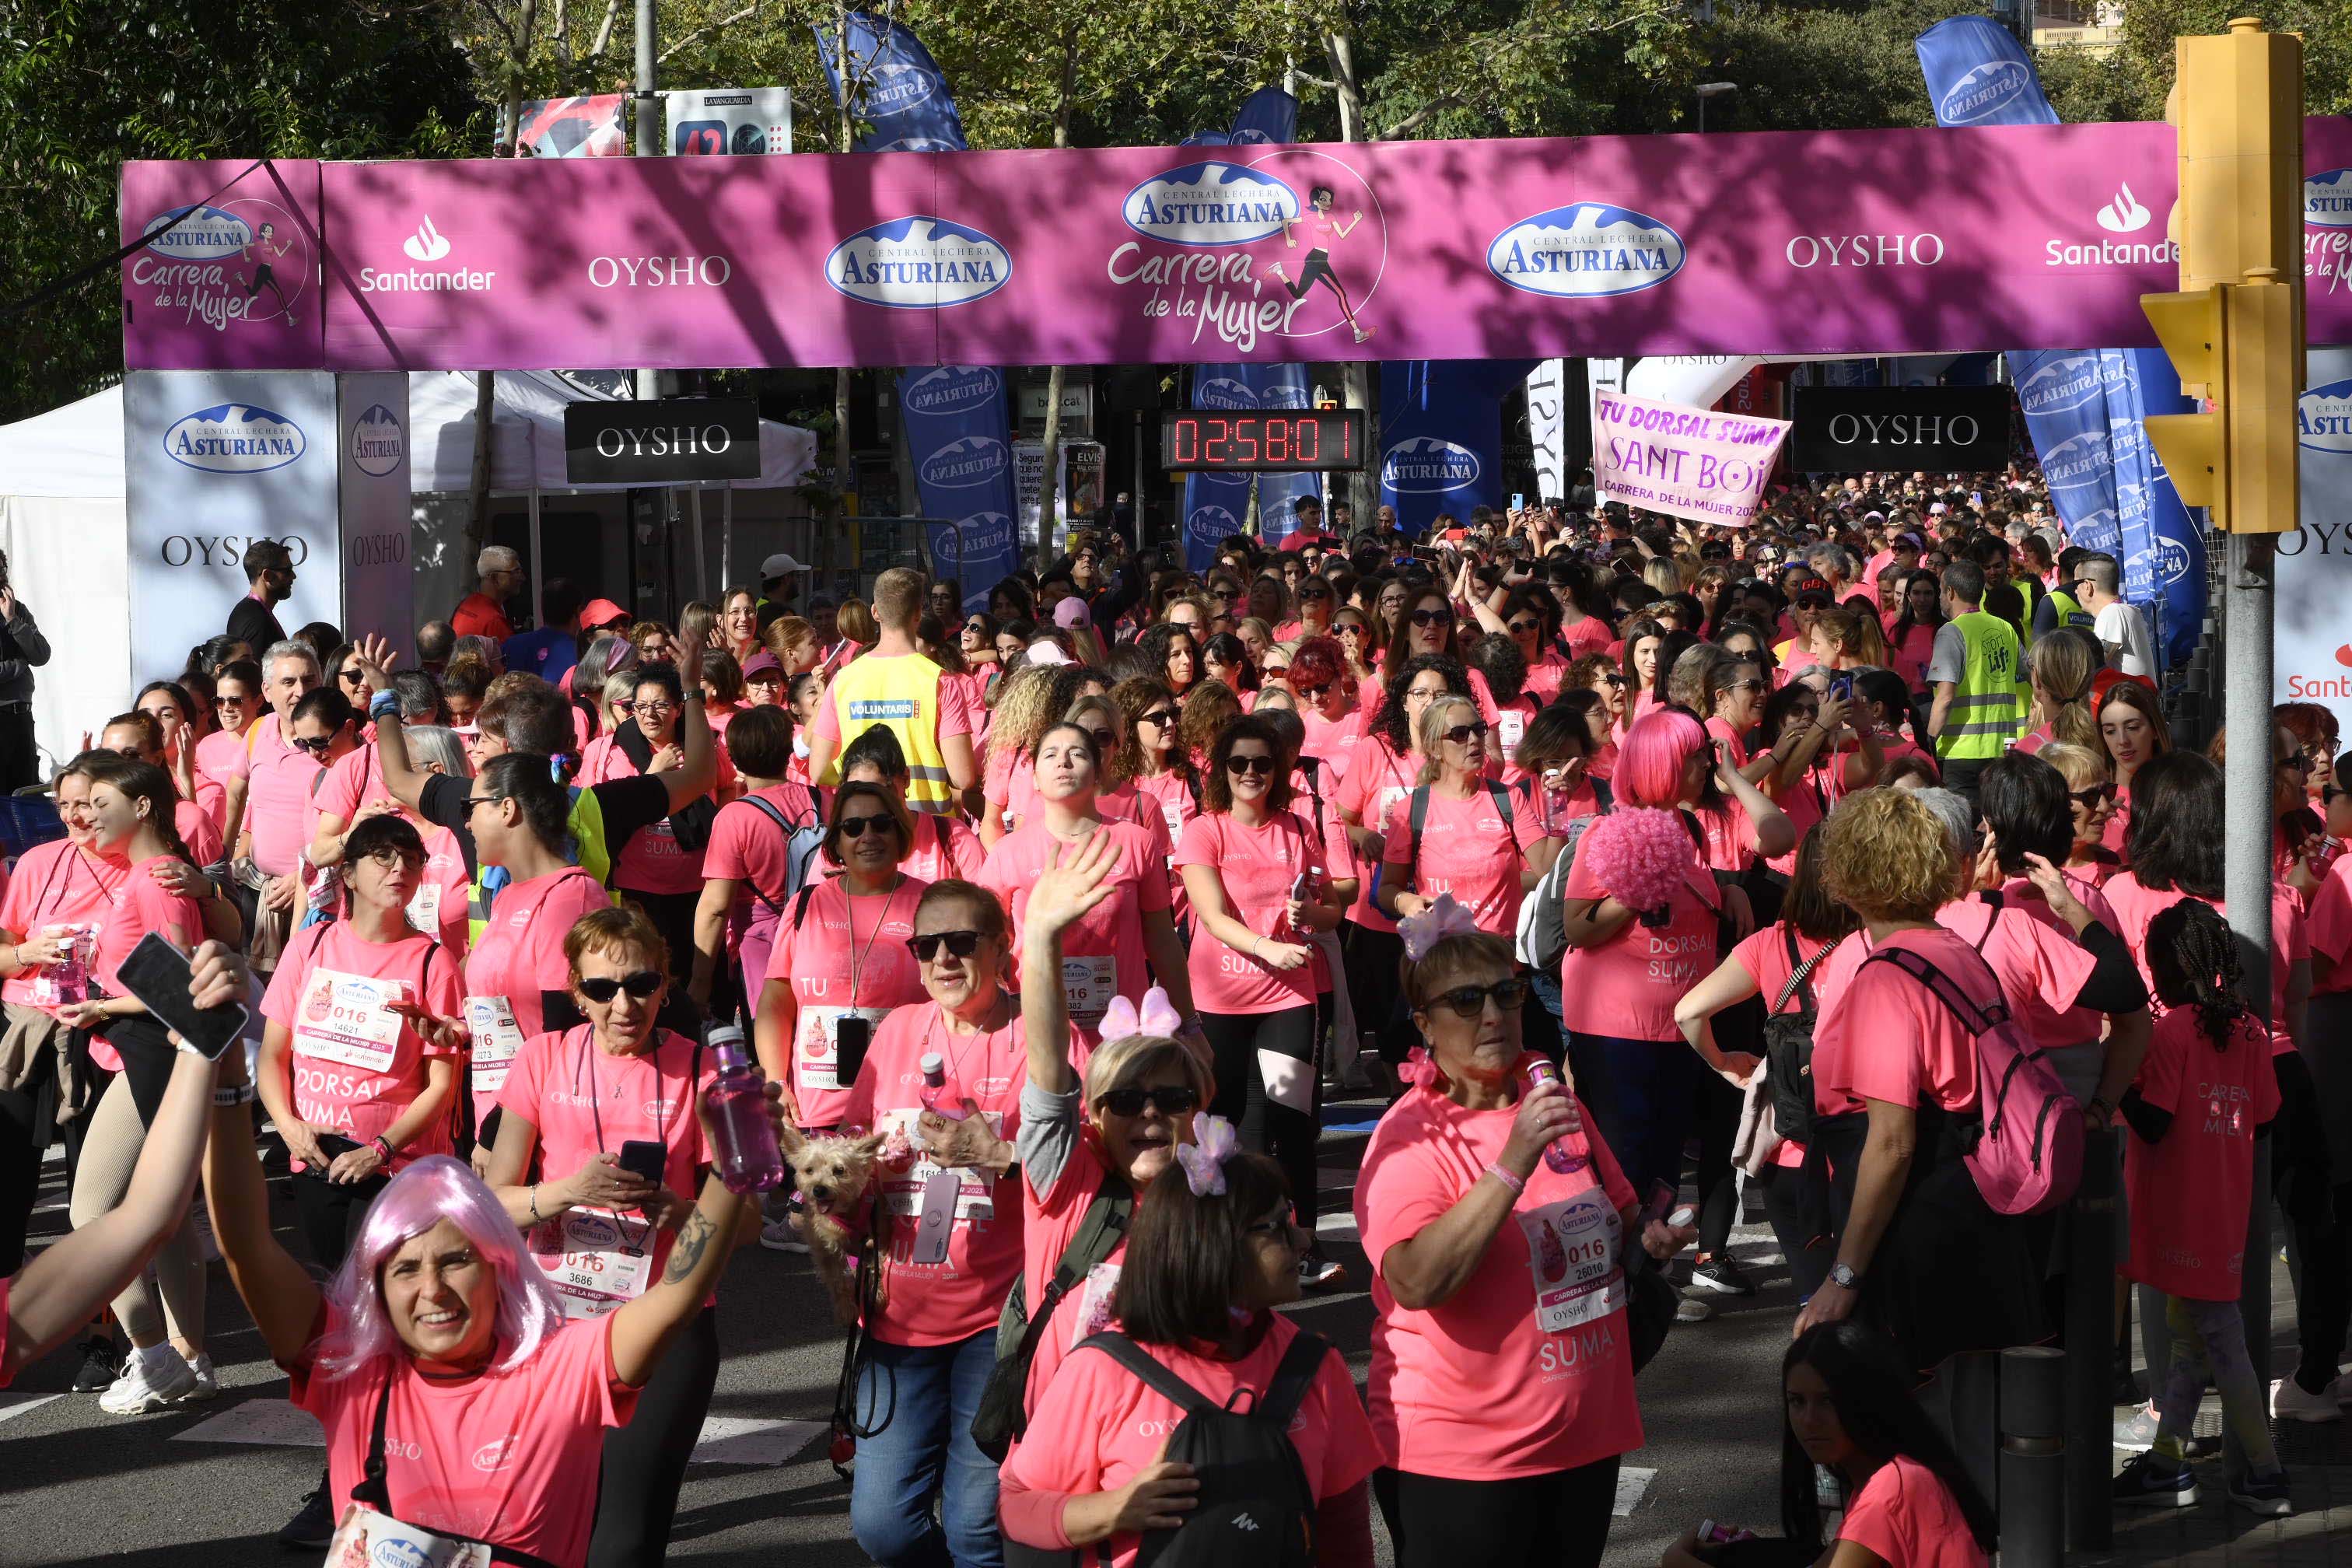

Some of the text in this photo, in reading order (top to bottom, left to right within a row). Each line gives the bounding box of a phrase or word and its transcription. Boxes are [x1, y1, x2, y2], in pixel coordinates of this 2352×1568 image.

[1164, 190, 1281, 200] CENTRAL LECHERA
[1136, 194, 1286, 225] ASTURIANA
[152, 226, 244, 246] ASTURIANA
[1533, 234, 1664, 245] CENTRAL LECHERA
[868, 247, 926, 257] CENTRAL
[1502, 239, 1671, 274] ASTURIANA
[1786, 233, 1944, 268] OYSHO
[2046, 238, 2181, 265] Santande
[132, 257, 224, 285] Carrera
[588, 255, 731, 287] OYSHO
[839, 251, 998, 285] ASTURIANA
[1108, 242, 1253, 285] Carrera
[2318, 255, 2332, 276] la
[360, 268, 495, 292] Santander
[155, 283, 259, 331] de la Mujer
[1143, 279, 1307, 353] de la Mujer
[1600, 399, 1627, 423] TU
[1629, 406, 1710, 439] DORSAL
[1829, 413, 1979, 446] OYSHO
[175, 429, 296, 456] ASTURIANA
[355, 432, 400, 458] ASTURIANA
[596, 425, 731, 457] OYSHO
[1077, 452, 1101, 462] ELVIS
[1605, 436, 1690, 484] SANT
[1384, 460, 1472, 481] ASTURIANA
[1020, 496, 1034, 505] este
[1605, 480, 1654, 500] CARRERA
[1659, 492, 1675, 505] DE
[1677, 495, 1691, 507] LA
[1695, 498, 1732, 515] MUJER
[161, 535, 308, 567] OYSO
[353, 533, 404, 567] OYSHO
[1983, 633, 2005, 656] Sport
[850, 705, 912, 715] VOLUNTARIS
[1423, 823, 1454, 835] OYSHO
[646, 840, 678, 855] SUM
[1427, 877, 1448, 894] TU
[1650, 933, 1712, 954] DORSAL
[1648, 961, 1699, 978] SUMA
[800, 977, 828, 996] TU
[1068, 988, 1087, 999] 16
[334, 1006, 368, 1024] 016
[334, 1023, 359, 1034] 14621
[306, 1028, 333, 1040] CARRERA
[350, 1038, 370, 1048] MUJER
[371, 1042, 386, 1051] 2023
[807, 1075, 835, 1083] OYSHO
[551, 1092, 600, 1109] OYSHO
[1561, 1209, 1601, 1231] ASTURIANA
[571, 1224, 613, 1243] ASTURIANA
[566, 1251, 605, 1272] 016
[1569, 1238, 1605, 1265] 016
[569, 1272, 593, 1286] 3686
[1576, 1262, 1604, 1280] 26010
[1554, 1286, 1583, 1302] CARRERA
[1553, 1303, 1588, 1321] OYSHO
[1540, 1324, 1615, 1372] SUMA
[384, 1437, 422, 1461] SHO
